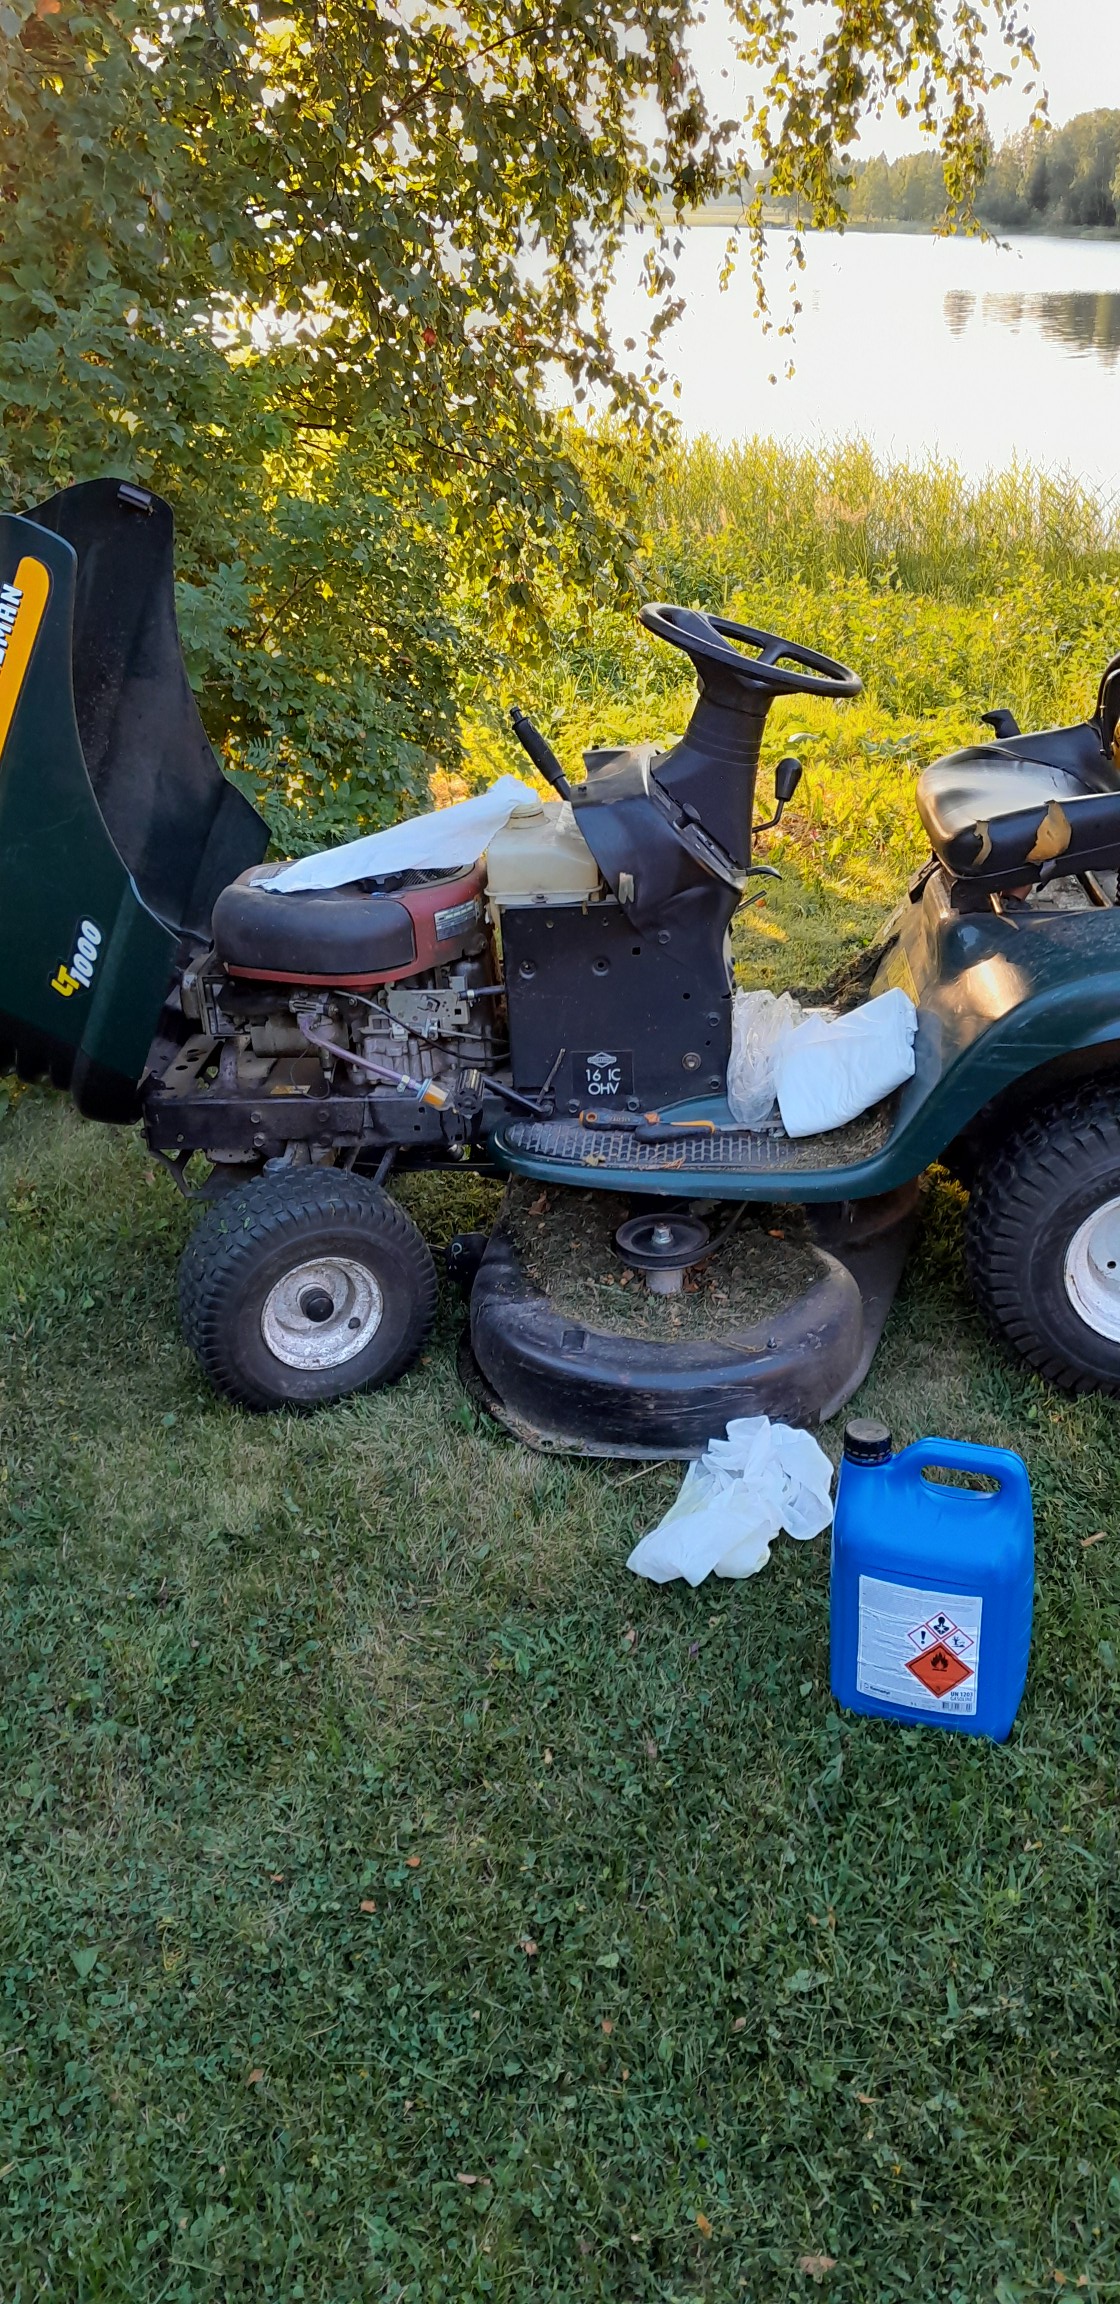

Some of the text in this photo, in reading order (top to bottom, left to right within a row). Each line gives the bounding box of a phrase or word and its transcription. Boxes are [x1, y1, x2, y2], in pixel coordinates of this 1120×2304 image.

[0, 584, 23, 665] MAN
[70, 920, 102, 988] 1000
[586, 1068, 602, 1082] 16
[588, 1082, 620, 1095] OHV
